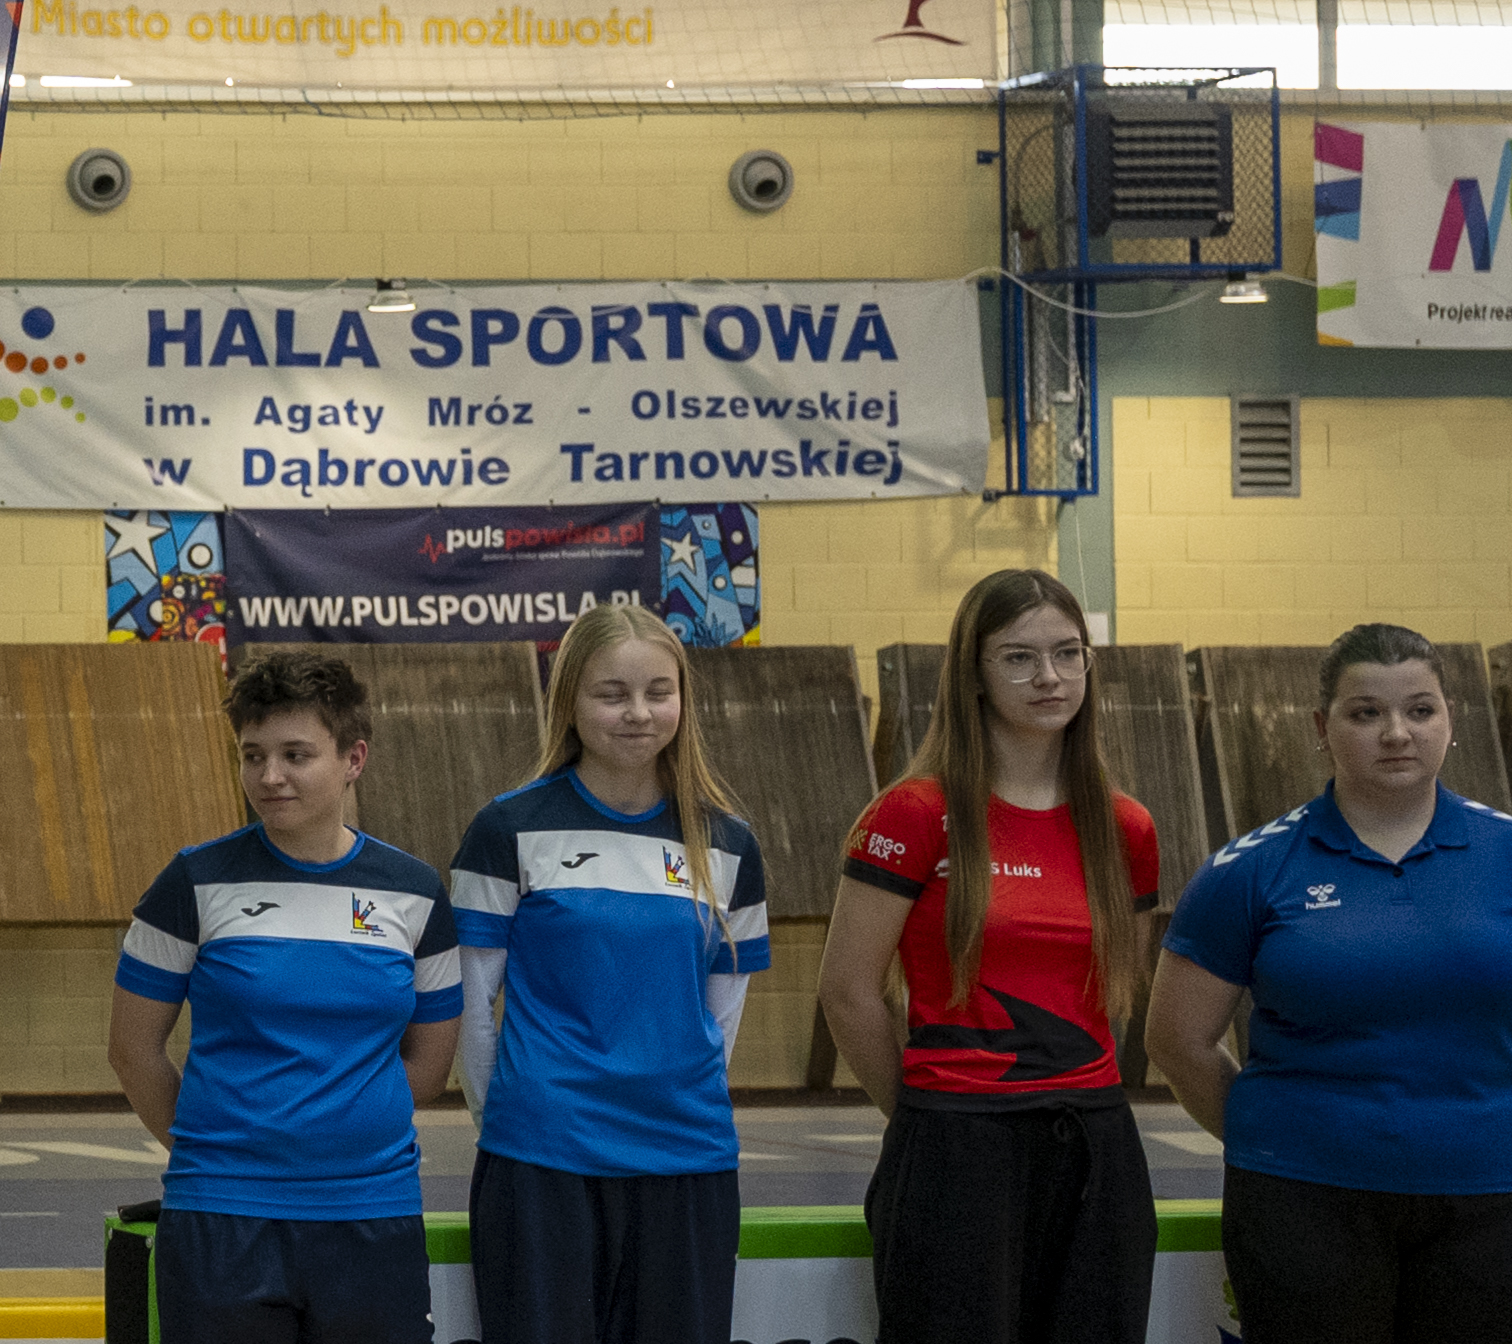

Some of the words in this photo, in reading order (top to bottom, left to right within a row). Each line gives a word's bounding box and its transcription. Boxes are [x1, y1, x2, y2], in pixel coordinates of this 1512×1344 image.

[187, 5, 403, 58] otwartych
[421, 5, 656, 48] możliwości
[1427, 302, 1487, 324] Projekt
[147, 307, 379, 369] HALA
[409, 301, 899, 368] SPORTOWA
[144, 395, 211, 426] im.
[253, 396, 386, 435] Agaty
[428, 391, 535, 425] Mróz
[630, 388, 901, 431] Olszewskiej
[144, 457, 194, 487] w
[241, 446, 512, 498] Dąbrowie
[560, 441, 904, 486] Tarnowskiej
[867, 843, 892, 862] TAX
[868, 832, 906, 856] ERGO
[1003, 862, 1042, 878] Luks
[1305, 897, 1342, 911] hummel
